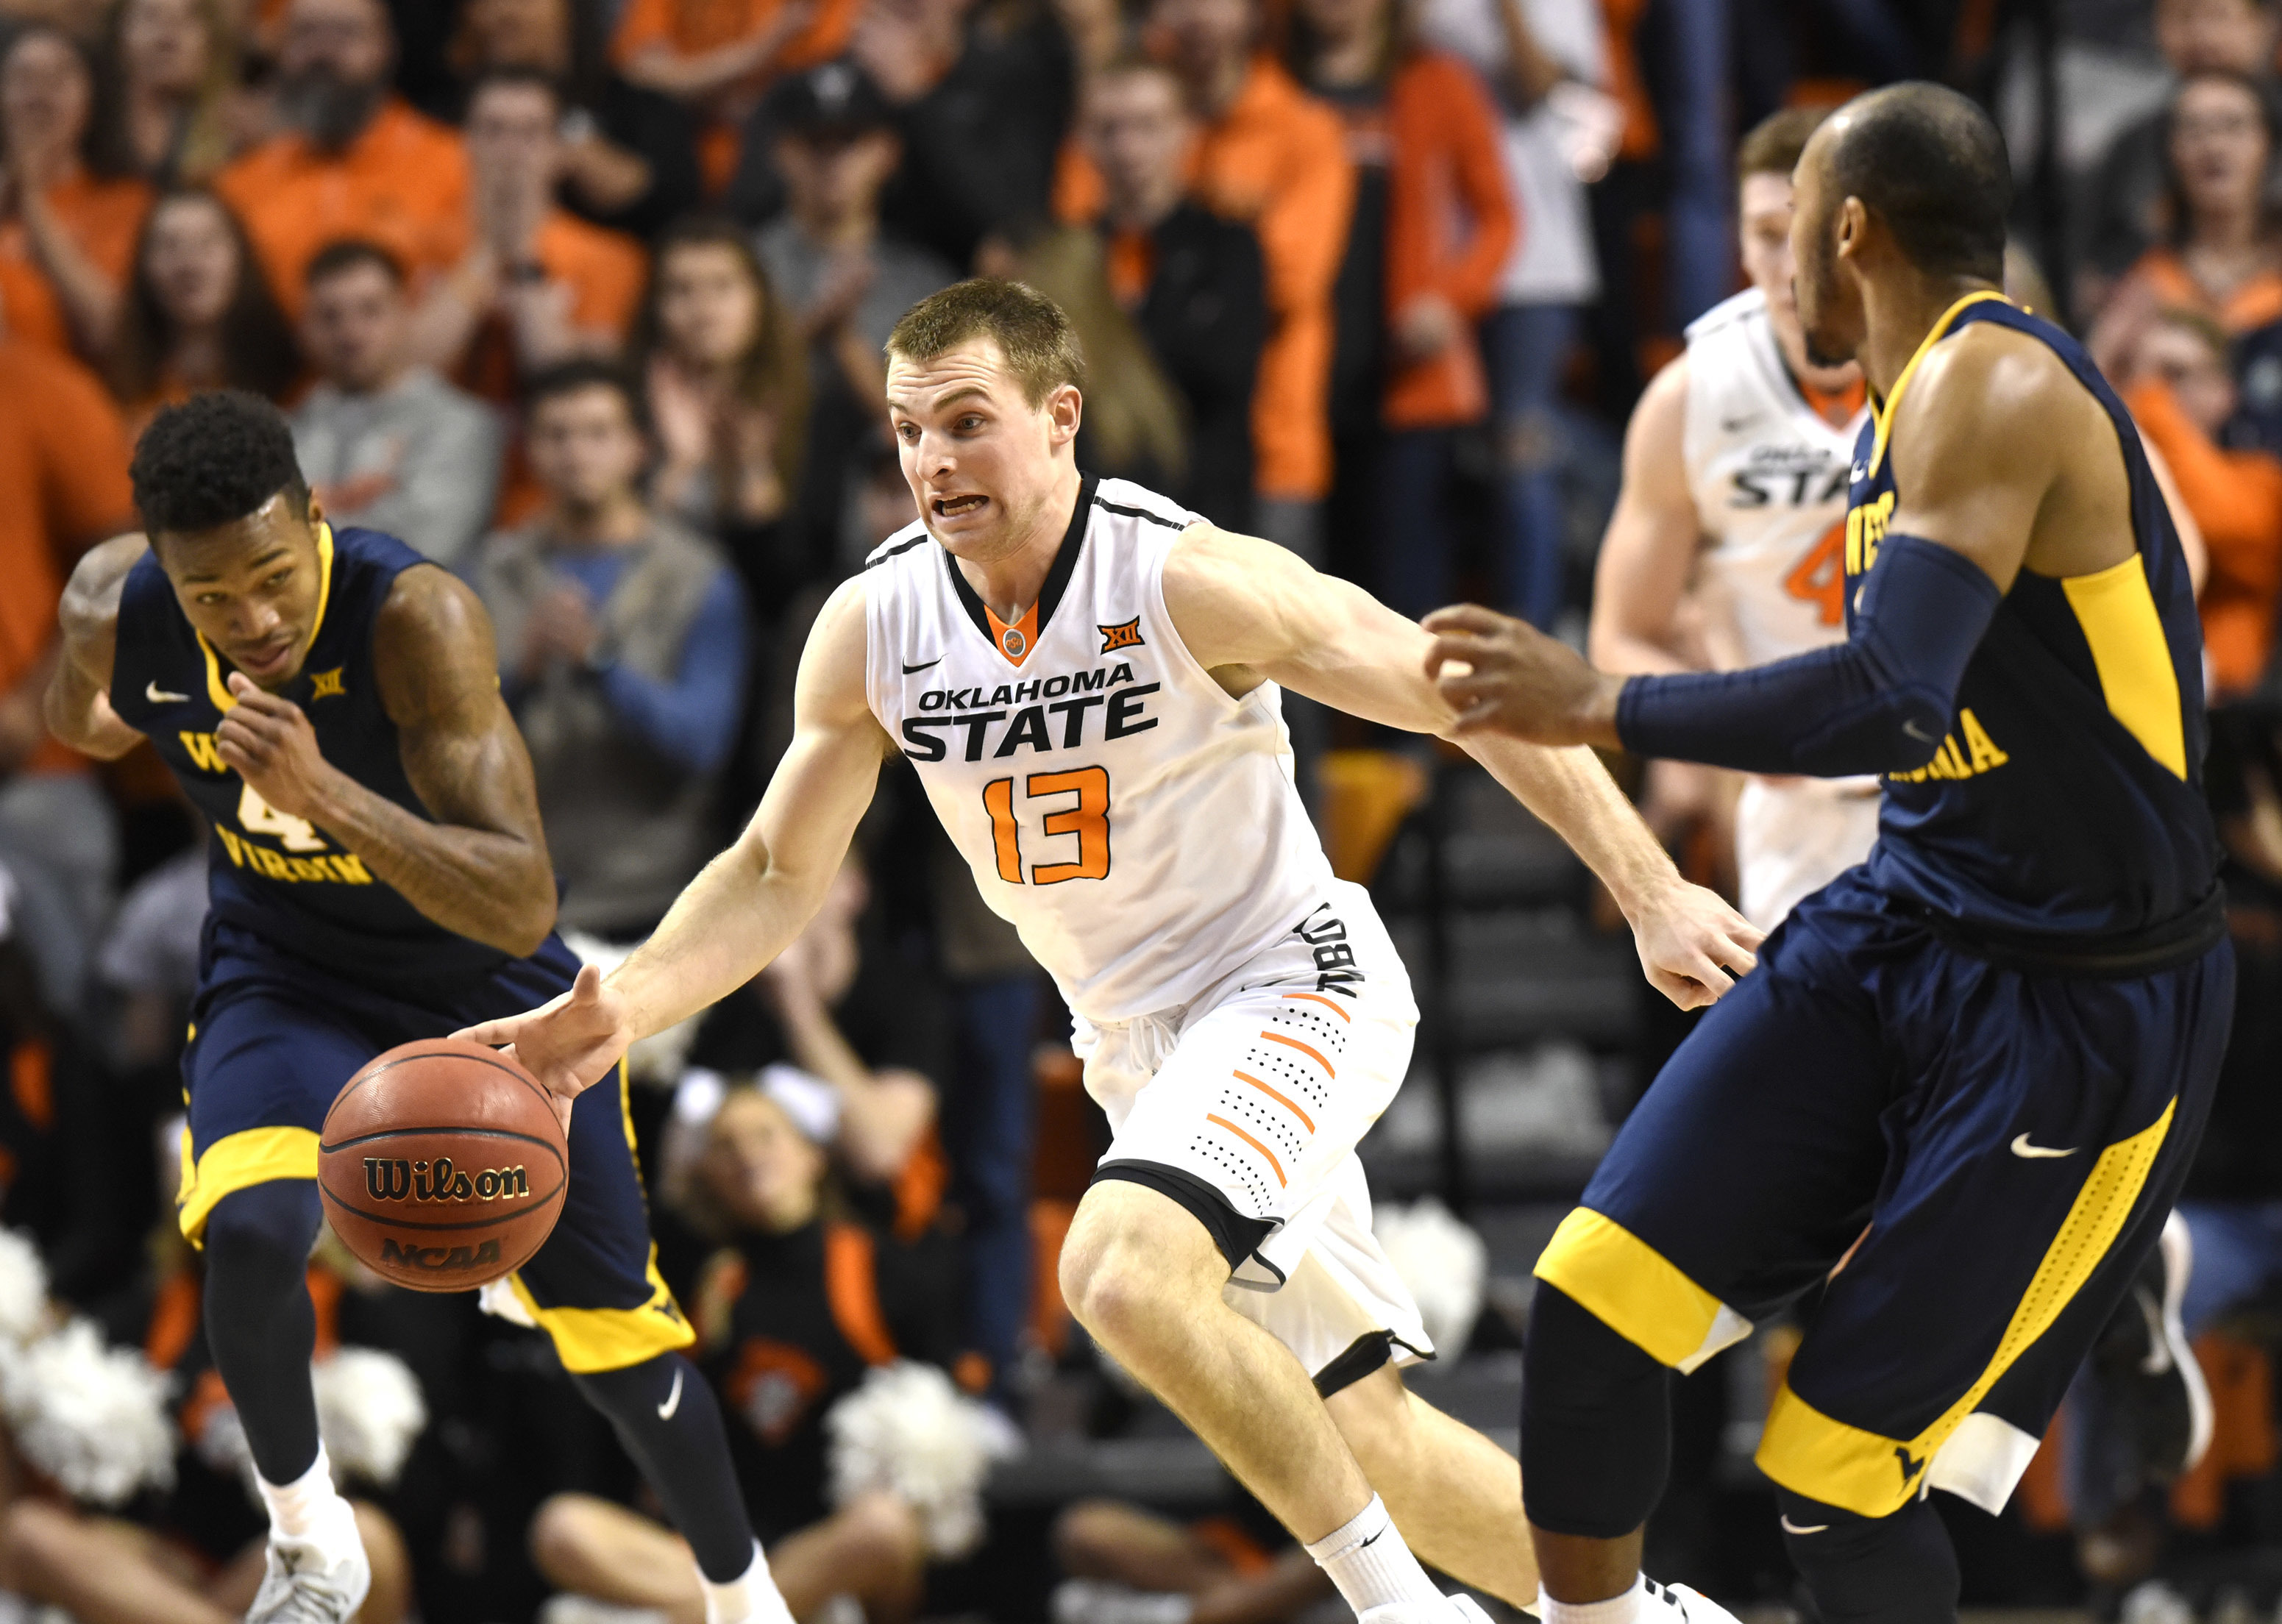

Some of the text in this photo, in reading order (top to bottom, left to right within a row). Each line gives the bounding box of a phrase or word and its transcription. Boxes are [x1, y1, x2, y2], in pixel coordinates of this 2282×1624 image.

[919, 662, 1134, 711] OKLAHOMA
[902, 681, 1161, 762] STATE
[982, 765, 1111, 886] 13
[363, 1157, 530, 1203] Wilson
[380, 1237, 500, 1270] NCAA
